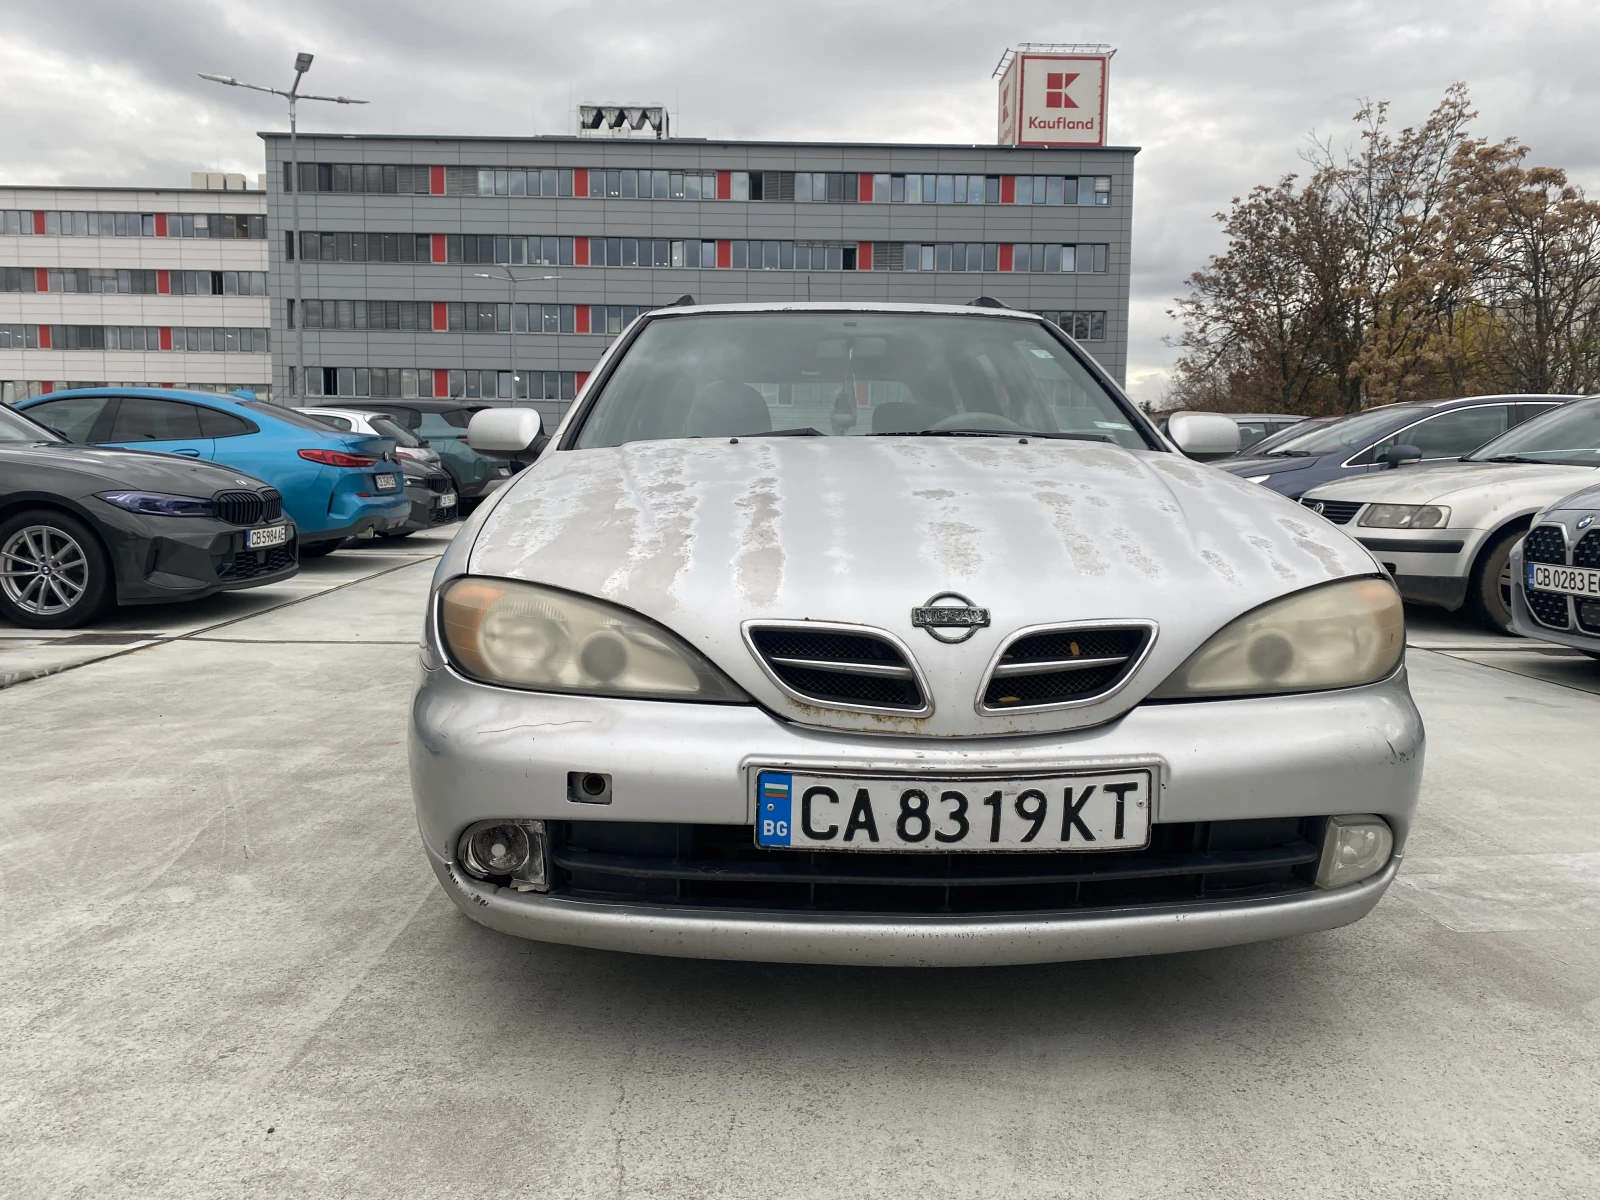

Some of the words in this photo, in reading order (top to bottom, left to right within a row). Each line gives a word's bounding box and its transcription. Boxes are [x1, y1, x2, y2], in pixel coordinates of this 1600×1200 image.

[1029, 116, 1094, 130] Kaufland
[252, 531, 261, 546] CB
[1535, 567, 1551, 587] CB
[1553, 569, 1585, 591] 0283
[1588, 572, 1600, 593] E
[801, 785, 880, 843] CA
[896, 787, 1048, 843] 8319
[1060, 781, 1139, 842] KT
[763, 819, 788, 837] BG
